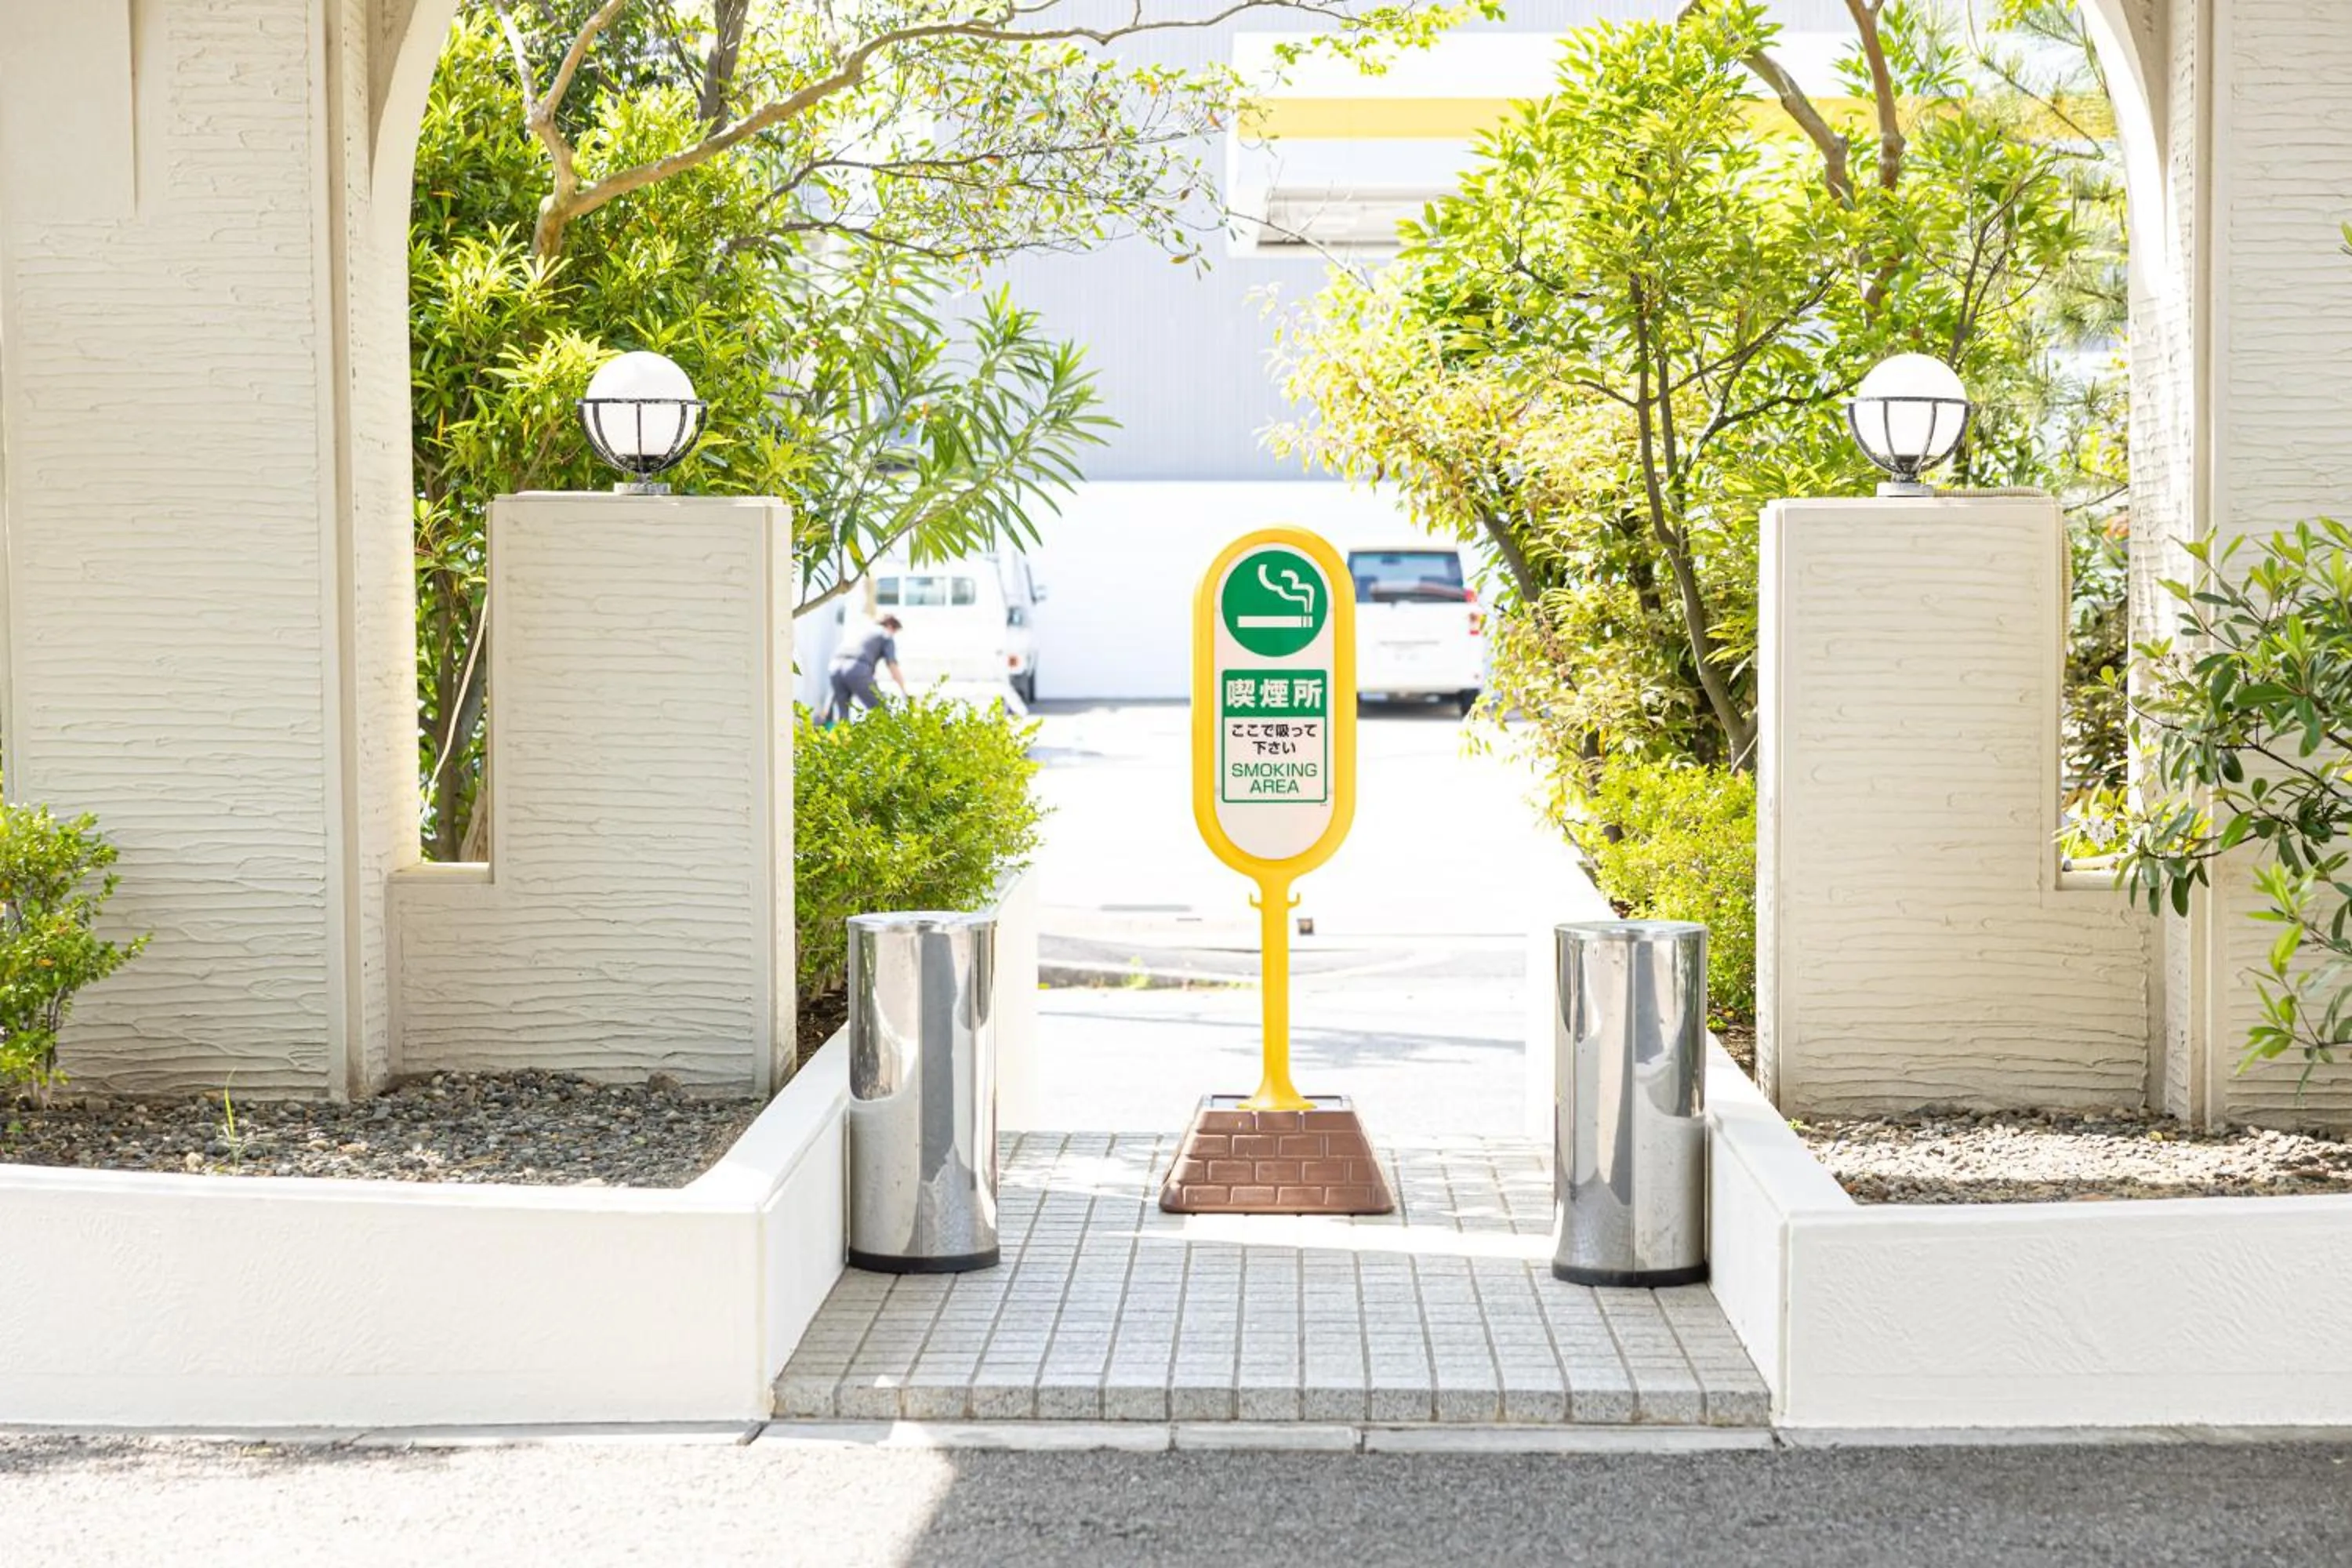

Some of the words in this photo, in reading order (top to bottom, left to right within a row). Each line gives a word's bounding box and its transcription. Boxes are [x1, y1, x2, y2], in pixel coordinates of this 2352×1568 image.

[1226, 678, 1323, 708] 喫煙所
[1232, 724, 1317, 738] ここで吸って
[1252, 741, 1296, 755] 下さい
[1232, 763, 1318, 778] SMOKING
[1249, 779, 1299, 793] AREA
